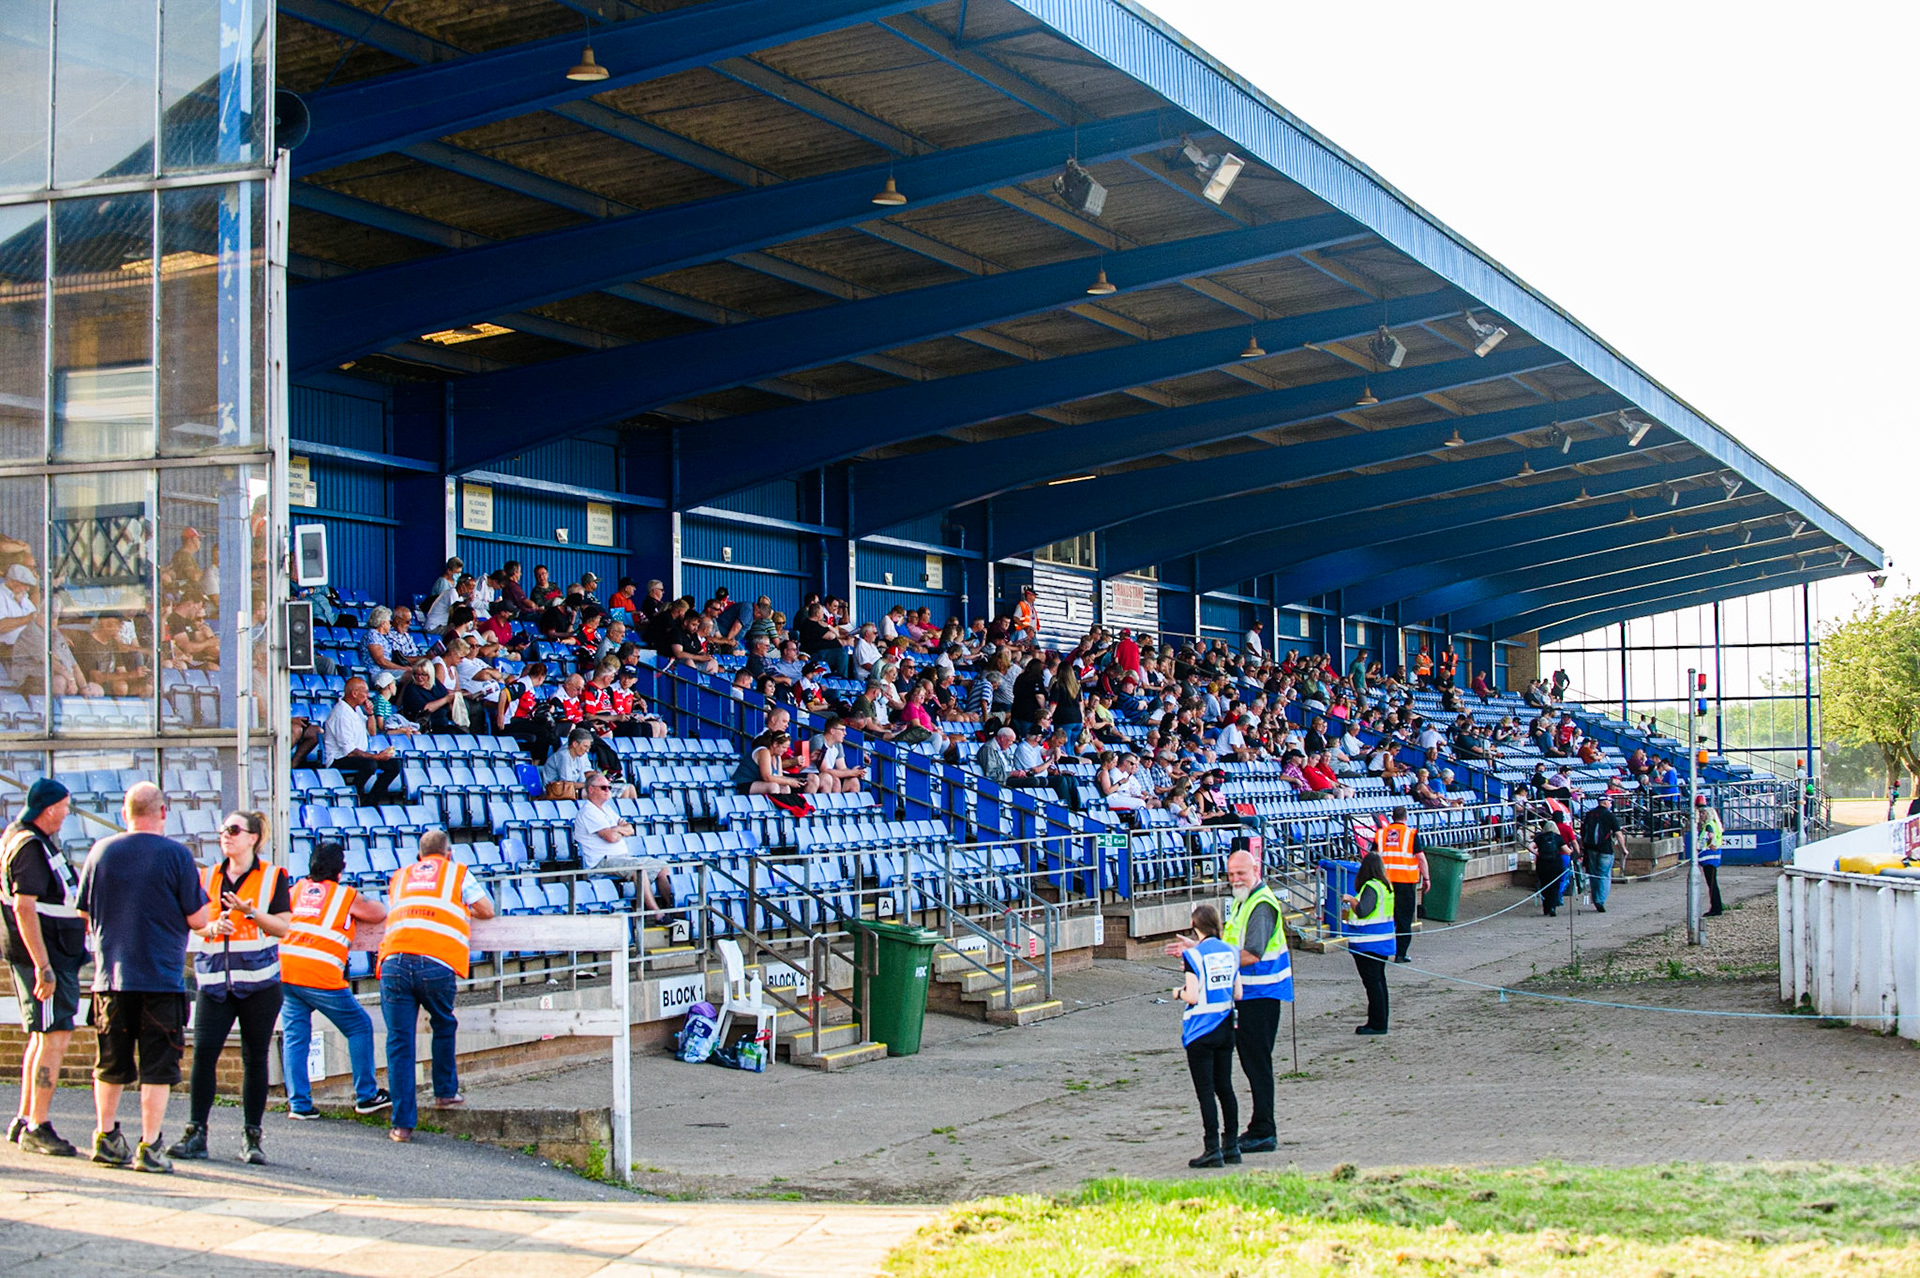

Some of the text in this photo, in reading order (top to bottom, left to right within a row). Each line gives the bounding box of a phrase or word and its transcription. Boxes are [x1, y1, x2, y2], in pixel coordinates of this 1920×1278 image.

[1114, 583, 1143, 599] GRANDSTAND
[882, 901, 889, 909] A
[677, 925, 685, 934] A
[915, 966, 927, 977] HDC
[769, 971, 797, 986] BLOCK
[663, 984, 704, 1007] BLOCK 1
